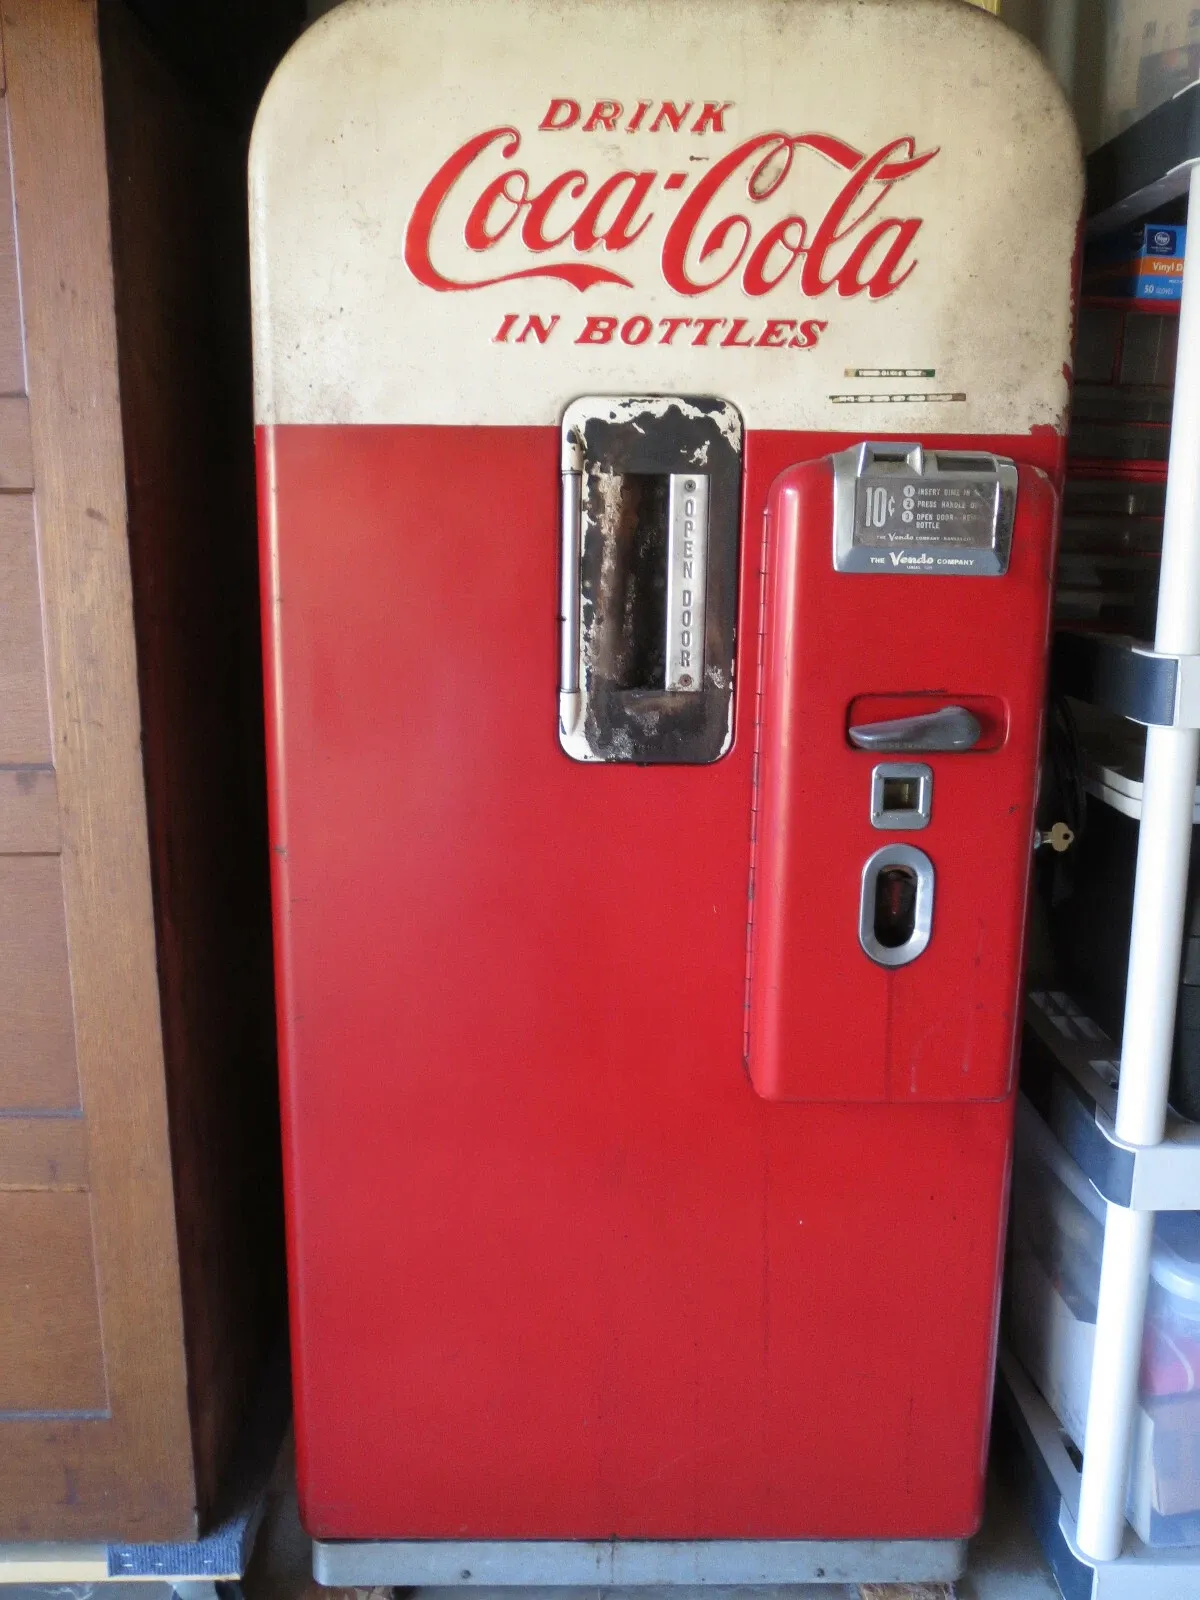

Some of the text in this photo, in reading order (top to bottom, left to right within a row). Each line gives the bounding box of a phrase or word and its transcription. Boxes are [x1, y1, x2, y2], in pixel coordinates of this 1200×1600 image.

[538, 98, 733, 133] DRINK
[403, 124, 941, 299] Coca-Cola
[1153, 261, 1174, 274] Vinyl
[1143, 284, 1154, 294] 50
[492, 314, 828, 349] IN BOTTLES
[917, 487, 941, 496] INSERT
[917, 500, 937, 508] PRESS
[941, 501, 965, 509] HANDLE
[916, 513, 933, 521] OPEN
[916, 521, 940, 529] BOTTLE
[888, 532, 914, 542] Vendo
[889, 550, 934, 566] Vendo
[937, 558, 975, 566] COMPANY
[680, 499, 695, 668] OPEN DOOR
